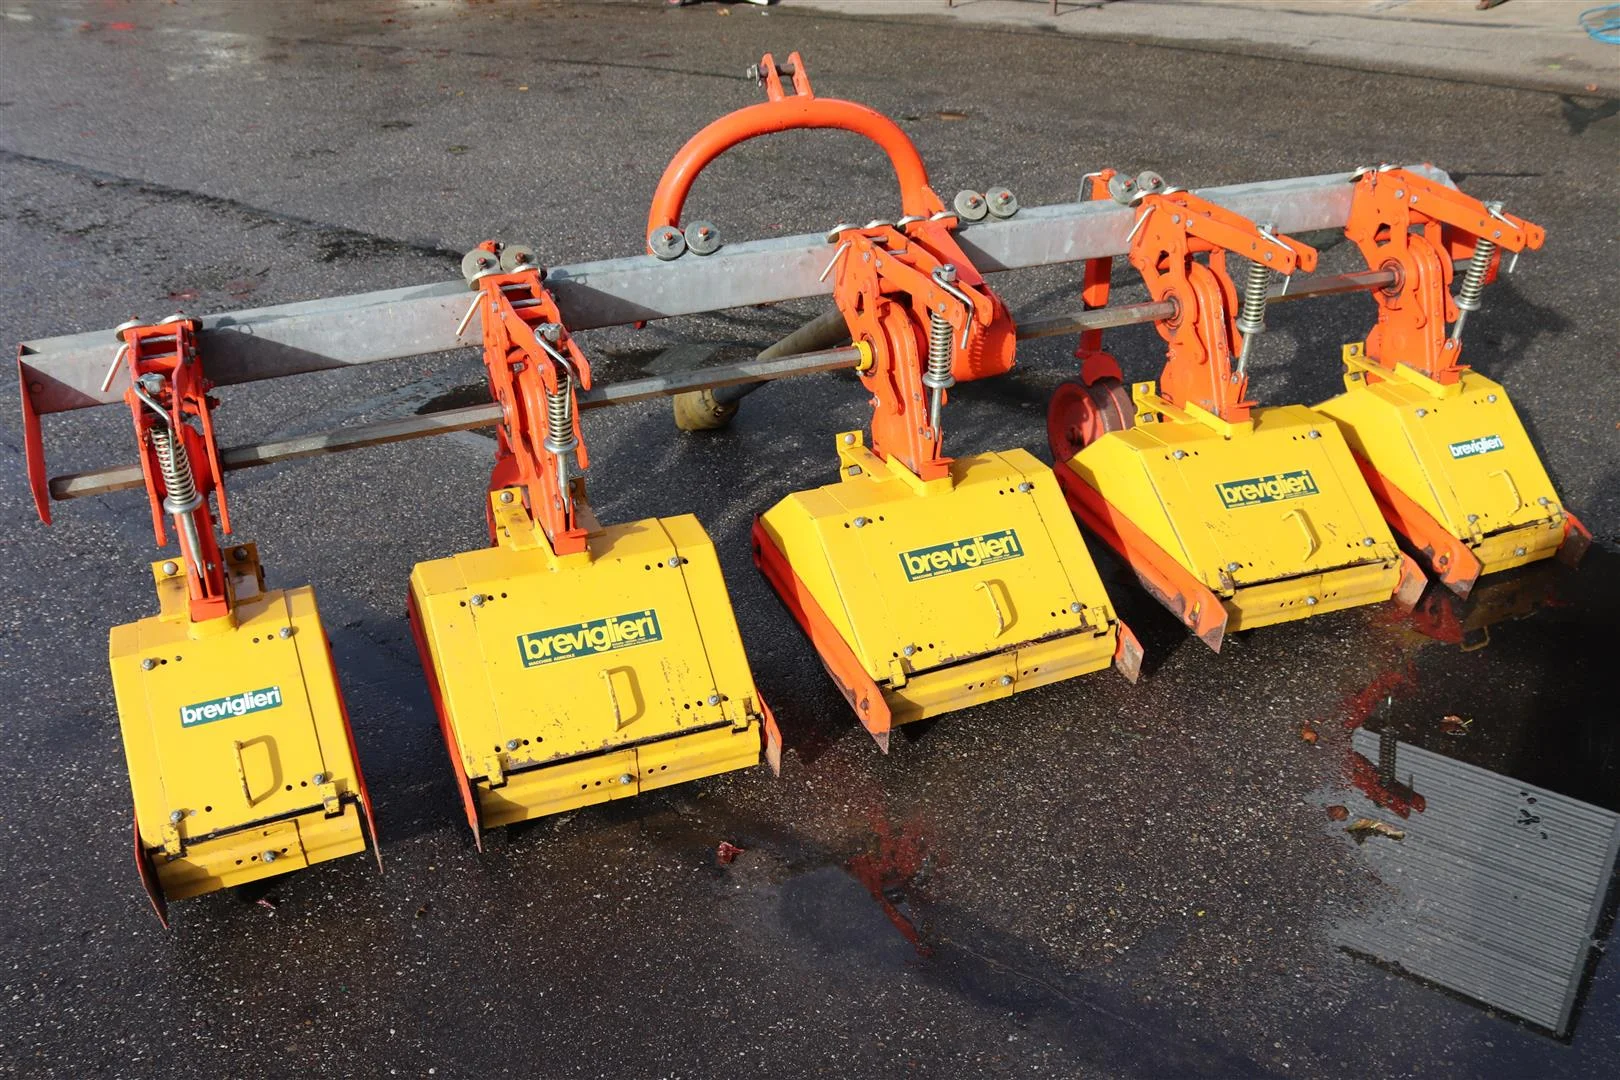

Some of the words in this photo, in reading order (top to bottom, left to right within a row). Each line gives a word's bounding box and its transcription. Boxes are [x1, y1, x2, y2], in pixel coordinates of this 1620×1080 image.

[1449, 434, 1503, 456] breviglieri
[1219, 470, 1314, 503] breviglieri
[902, 530, 1018, 575] breviglieri
[522, 610, 656, 660] breviglieri
[181, 686, 280, 723] breviglieri
